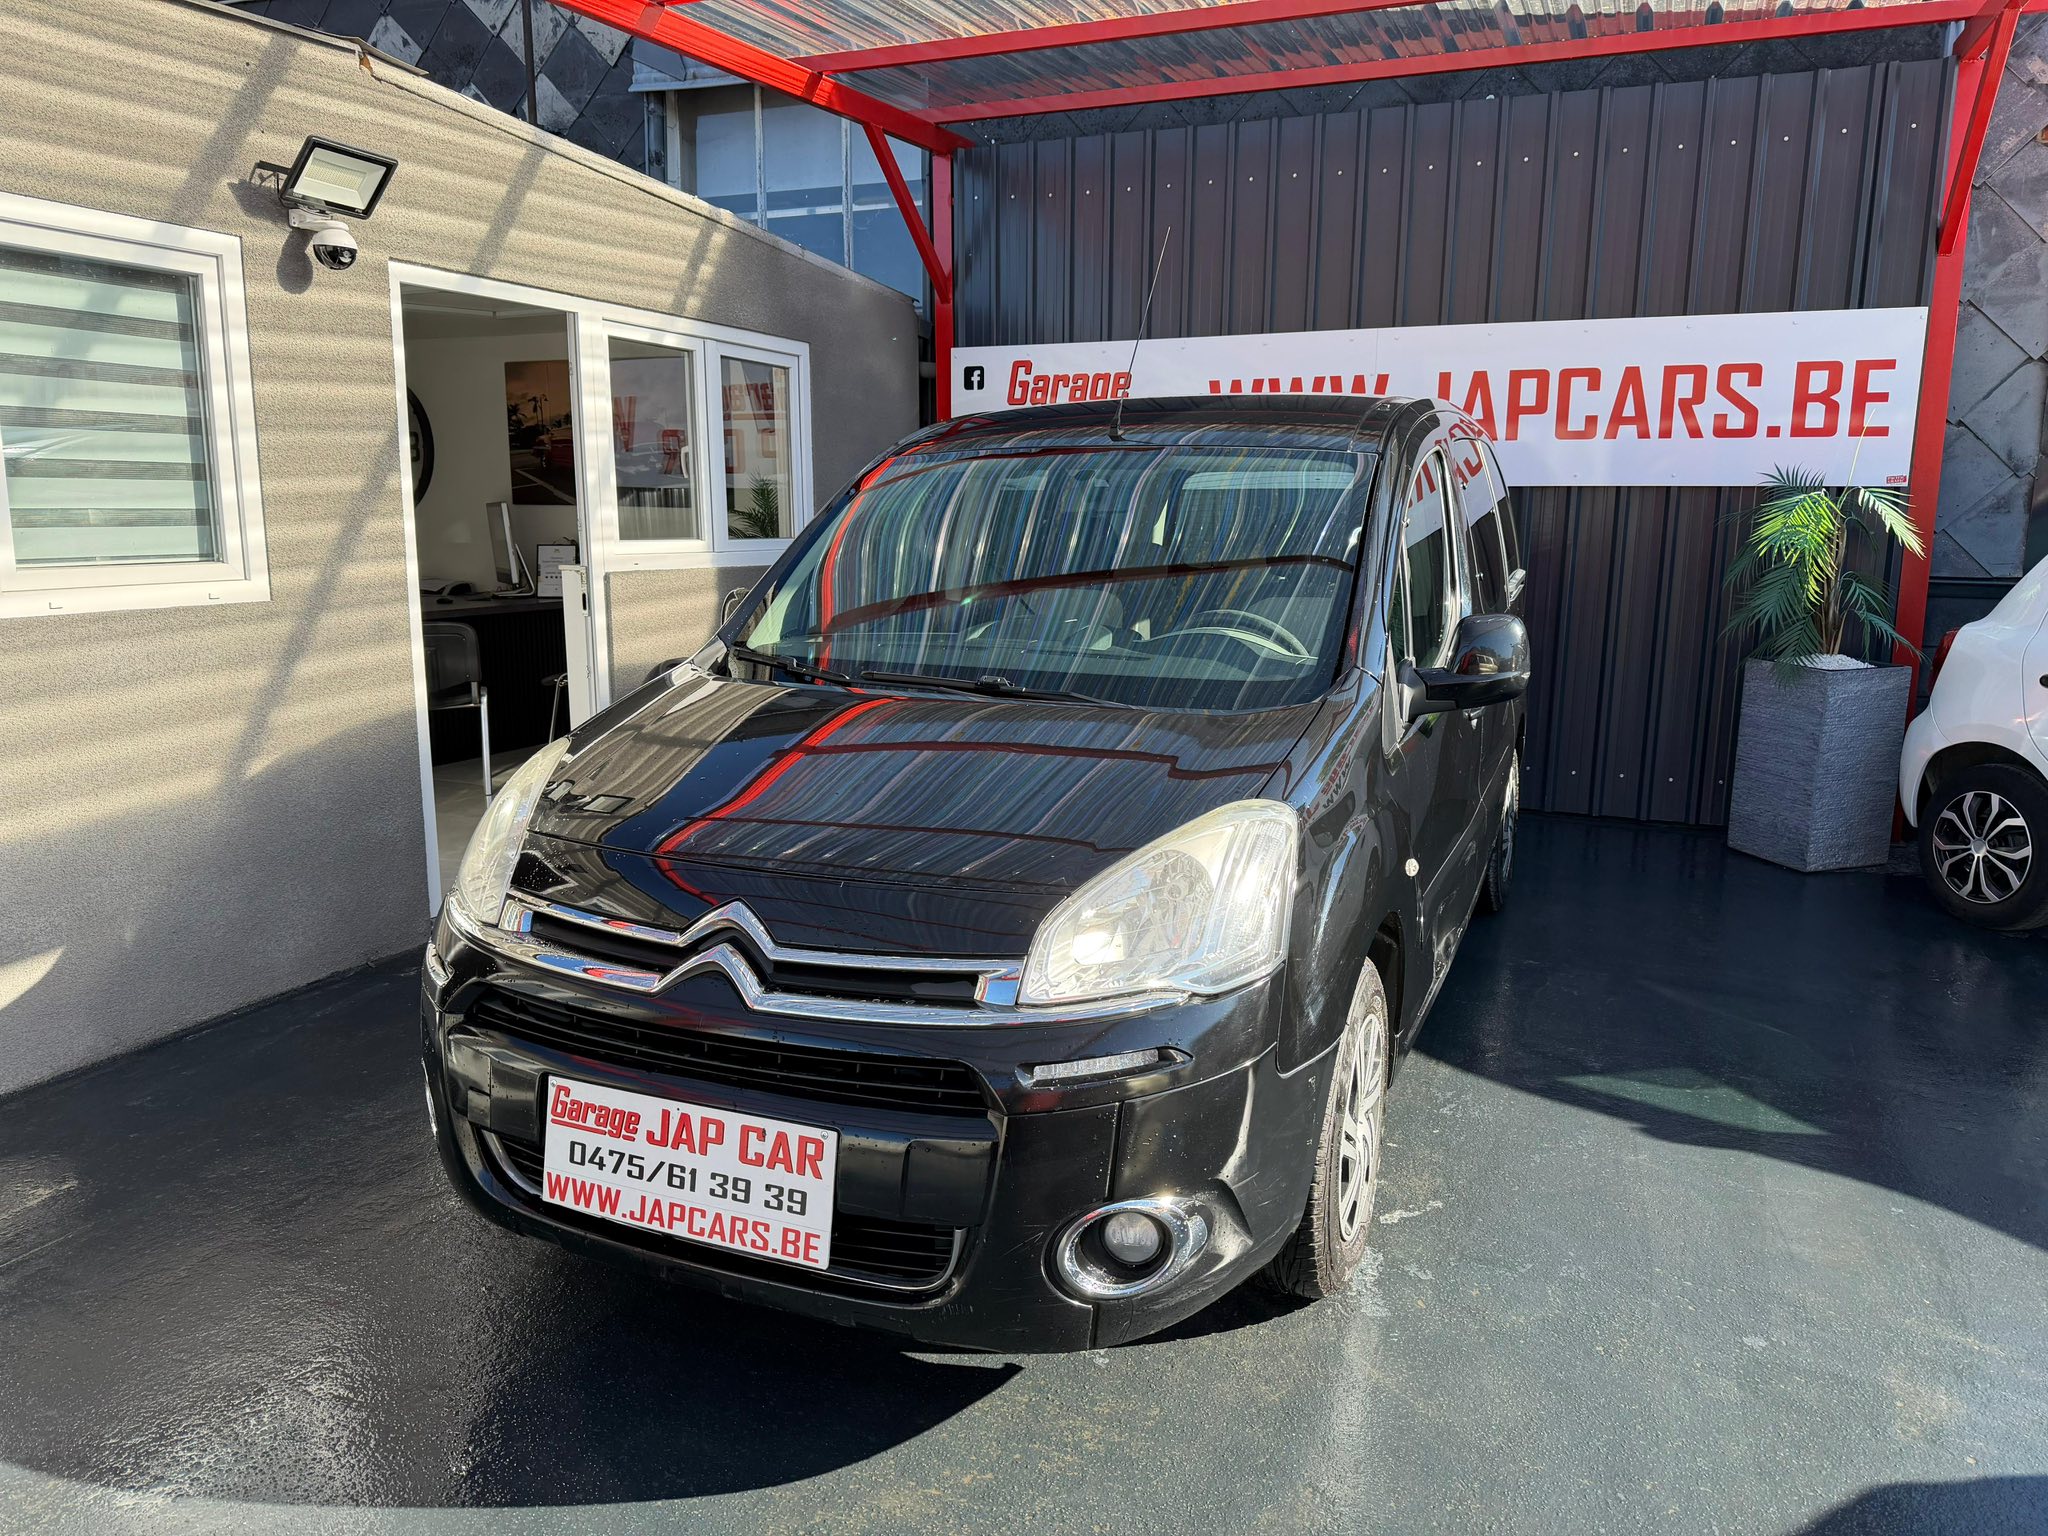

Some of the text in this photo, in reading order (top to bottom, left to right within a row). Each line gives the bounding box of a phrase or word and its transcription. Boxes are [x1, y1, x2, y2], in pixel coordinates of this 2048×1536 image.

[551, 1084, 825, 1180] Garage JAP CAR
[569, 1140, 807, 1216] 0475/61 39 39
[546, 1171, 821, 1264] WWW.JAPCARS.BE
